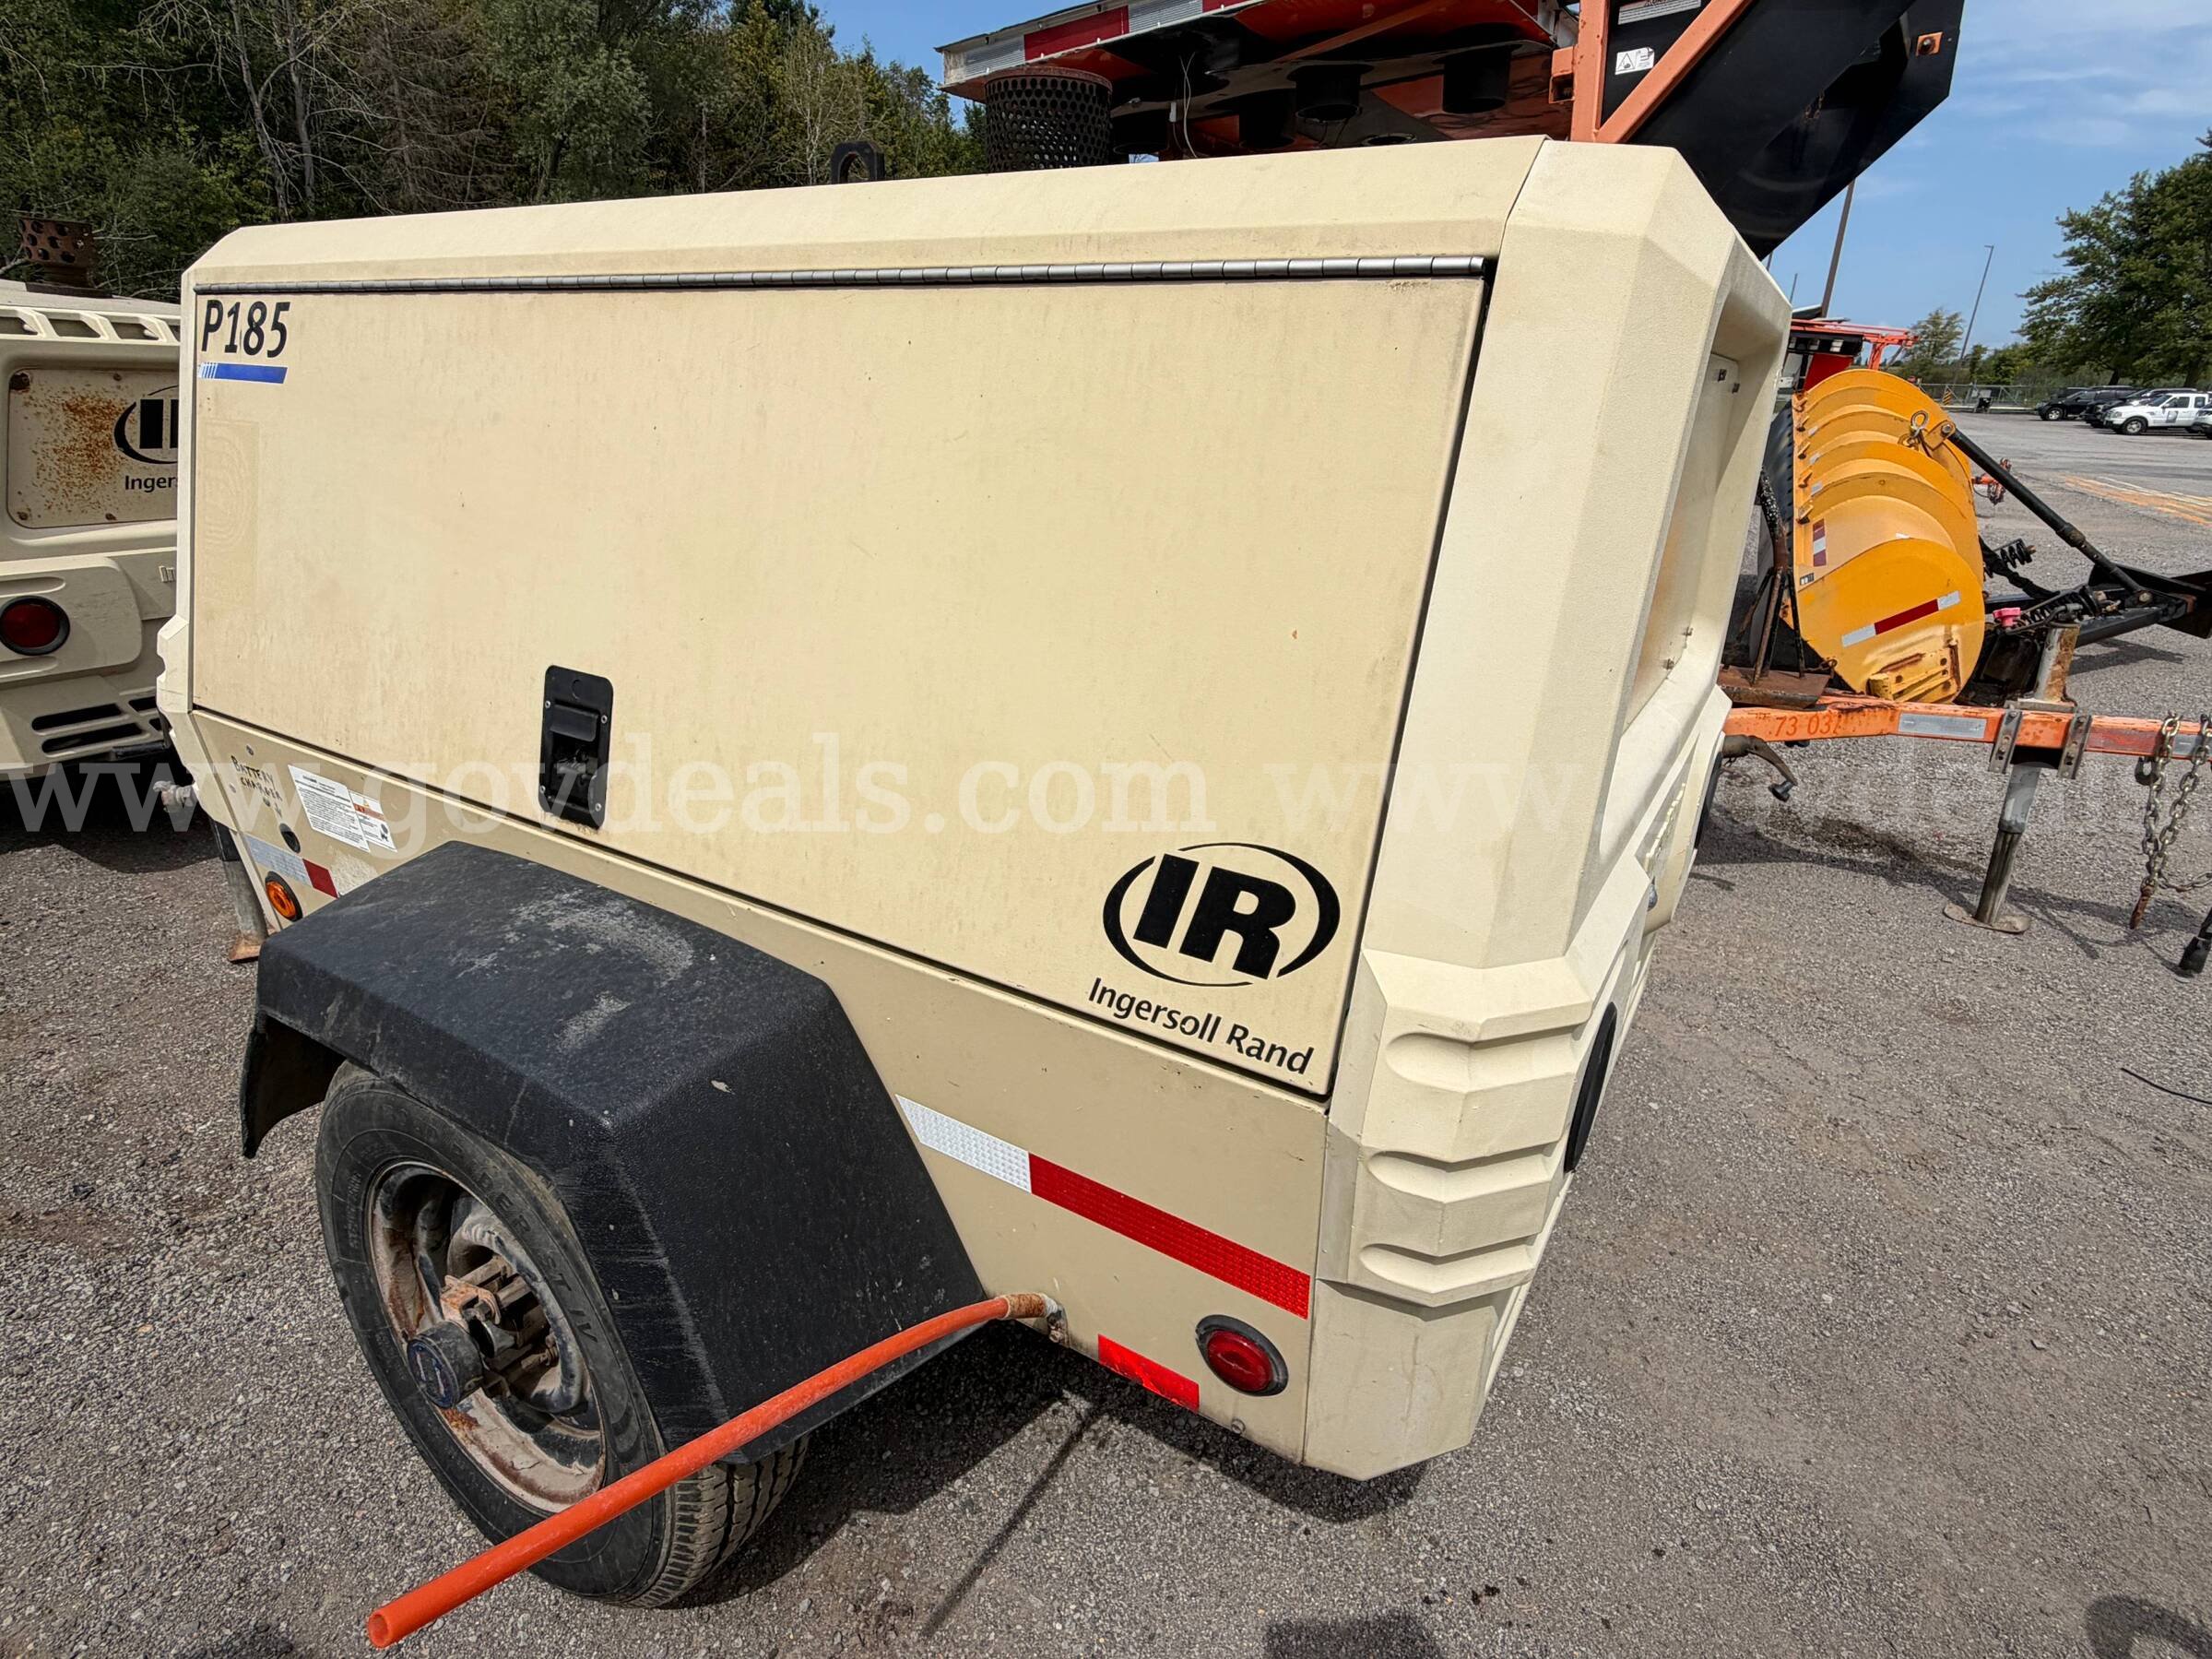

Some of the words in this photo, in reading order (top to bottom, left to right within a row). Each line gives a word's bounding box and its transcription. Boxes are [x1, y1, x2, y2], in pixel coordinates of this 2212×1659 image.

[201, 299, 291, 358] P185
[124, 475, 178, 493] Inger
[231, 754, 277, 790] BATTERY
[1133, 852, 1296, 980] IR
[1087, 977, 1223, 1044] Ingersoll
[1225, 1023, 1315, 1075] Rand
